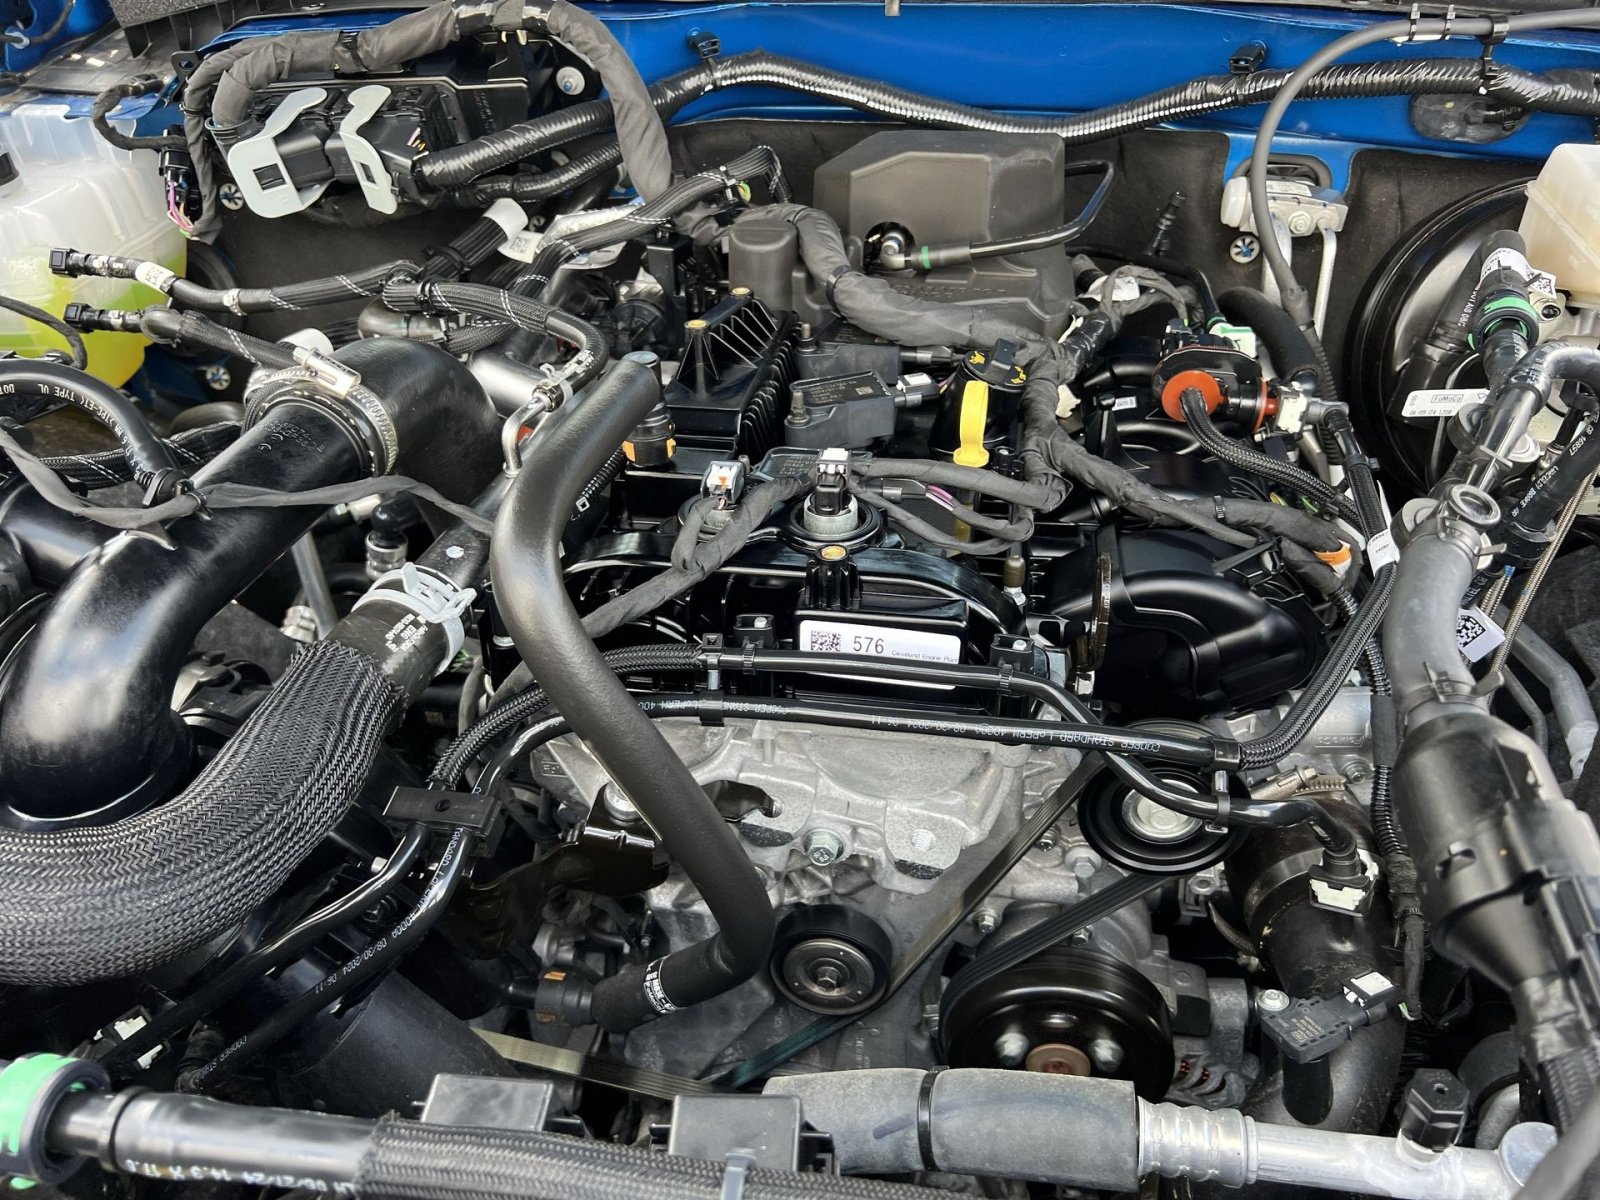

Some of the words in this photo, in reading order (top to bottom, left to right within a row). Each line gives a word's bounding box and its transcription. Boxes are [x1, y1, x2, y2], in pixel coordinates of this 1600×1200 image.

[37, 383, 50, 395] VL
[54, 386, 75, 402] TYPE
[853, 635, 884, 655] 576
[891, 649, 920, 660] Cleveland
[922, 653, 942, 662] Engine
[1059, 731, 1116, 747] STANDARD
[1120, 741, 1161, 753] COOPER
[441, 826, 464, 867] TANDARD
[390, 911, 417, 939] 4000A
[342, 937, 388, 976] 08/30/2024
[644, 981, 662, 1011] FoMoCo
